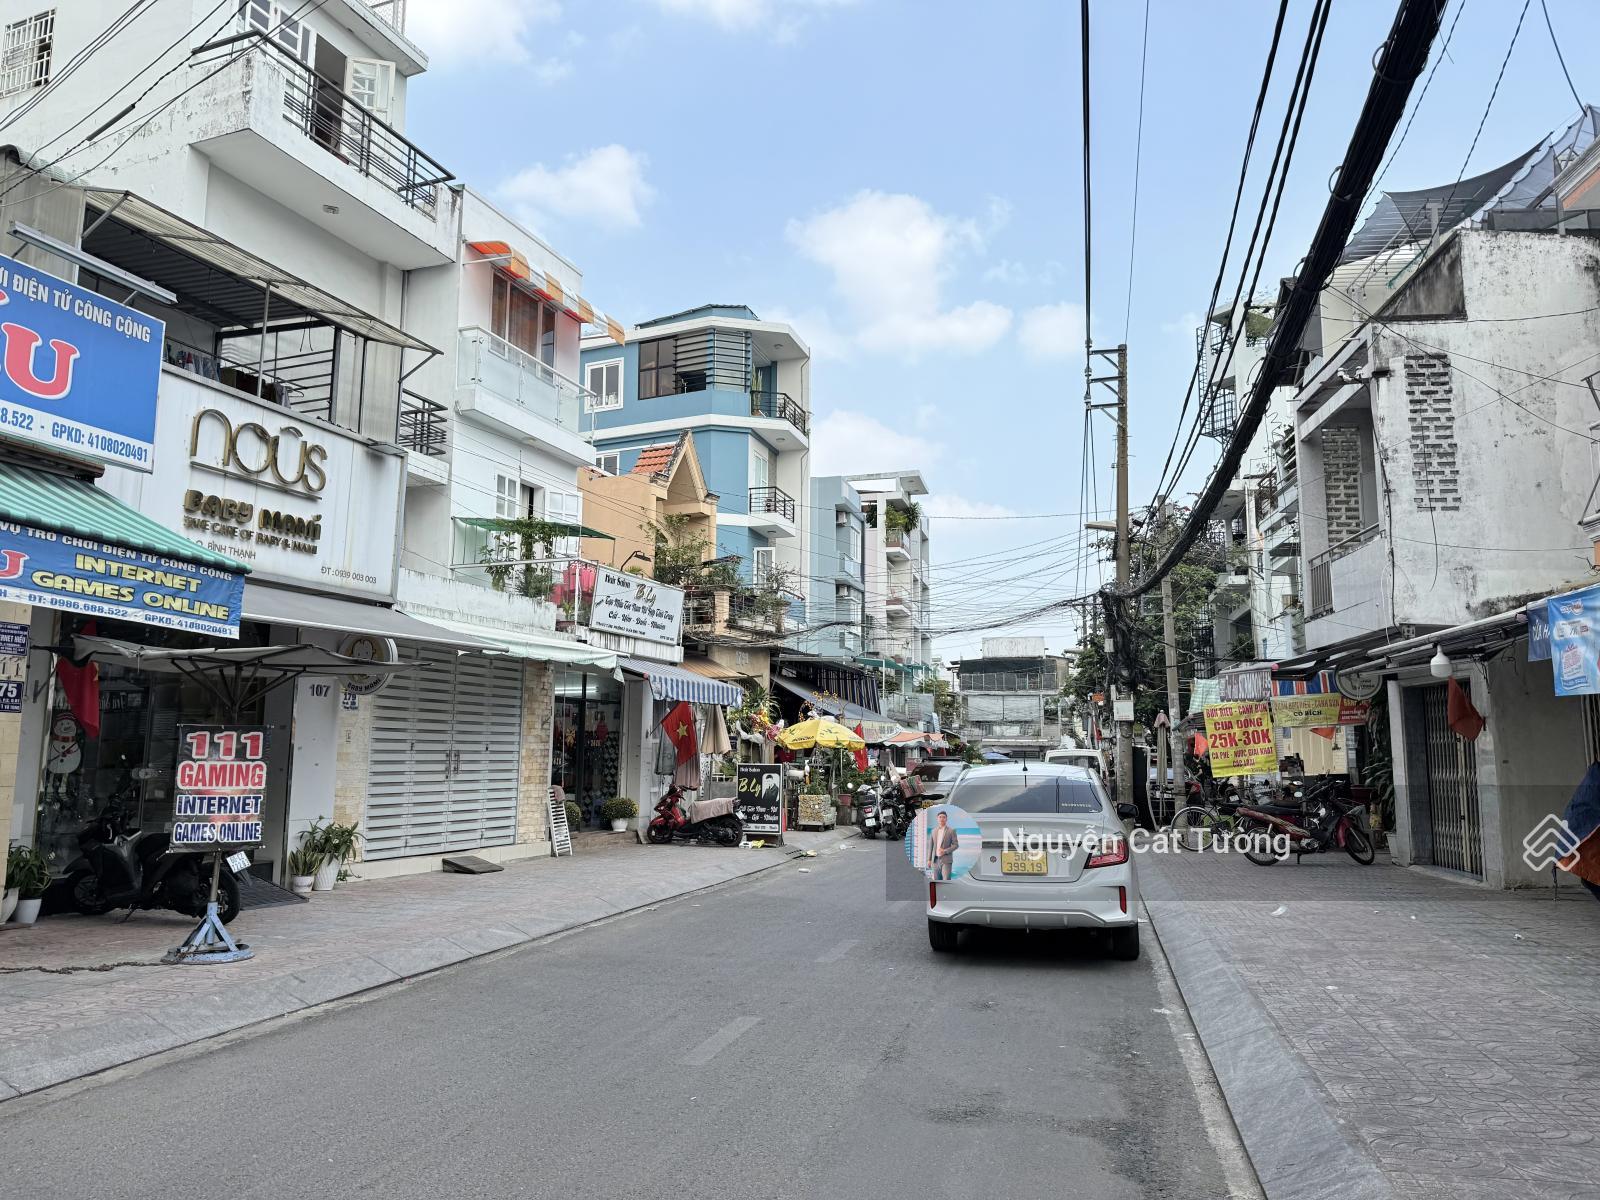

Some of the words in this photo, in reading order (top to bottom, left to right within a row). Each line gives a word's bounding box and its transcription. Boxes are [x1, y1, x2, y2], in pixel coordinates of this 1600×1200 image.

[13, 274, 48, 303] ĐIỆN
[54, 288, 73, 311] TỬ
[75, 300, 111, 328] CÔNG
[115, 316, 151, 343] CỘNG
[0, 407, 33, 430] 8.522
[52, 422, 85, 445] GPKD:
[87, 433, 148, 463] 4108020491
[239, 526, 254, 542] OF
[256, 530, 282, 548] BABY
[207, 541, 227, 554] BÌNH
[228, 546, 256, 560] THẠNH
[75, 553, 202, 593] INTERNET
[352, 572, 364, 582] 003
[365, 575, 377, 585] 003
[32, 570, 135, 602] GAMES
[143, 591, 230, 620] ONLINE
[28, 594, 46, 604] ĐT:
[50, 597, 128, 617] 0986.688.522
[145, 614, 175, 626] GPKD:
[310, 684, 330, 698] 107
[1214, 720, 1233, 731] CUA
[1209, 729, 1272, 749] 25K-30K
[177, 761, 267, 790] GAMING
[738, 777, 761, 797] B.Ly
[176, 795, 263, 815] INTERNET
[173, 822, 216, 843] GAMES
[218, 821, 262, 842] ONLINE
[1006, 862, 1043, 872] 399.19
